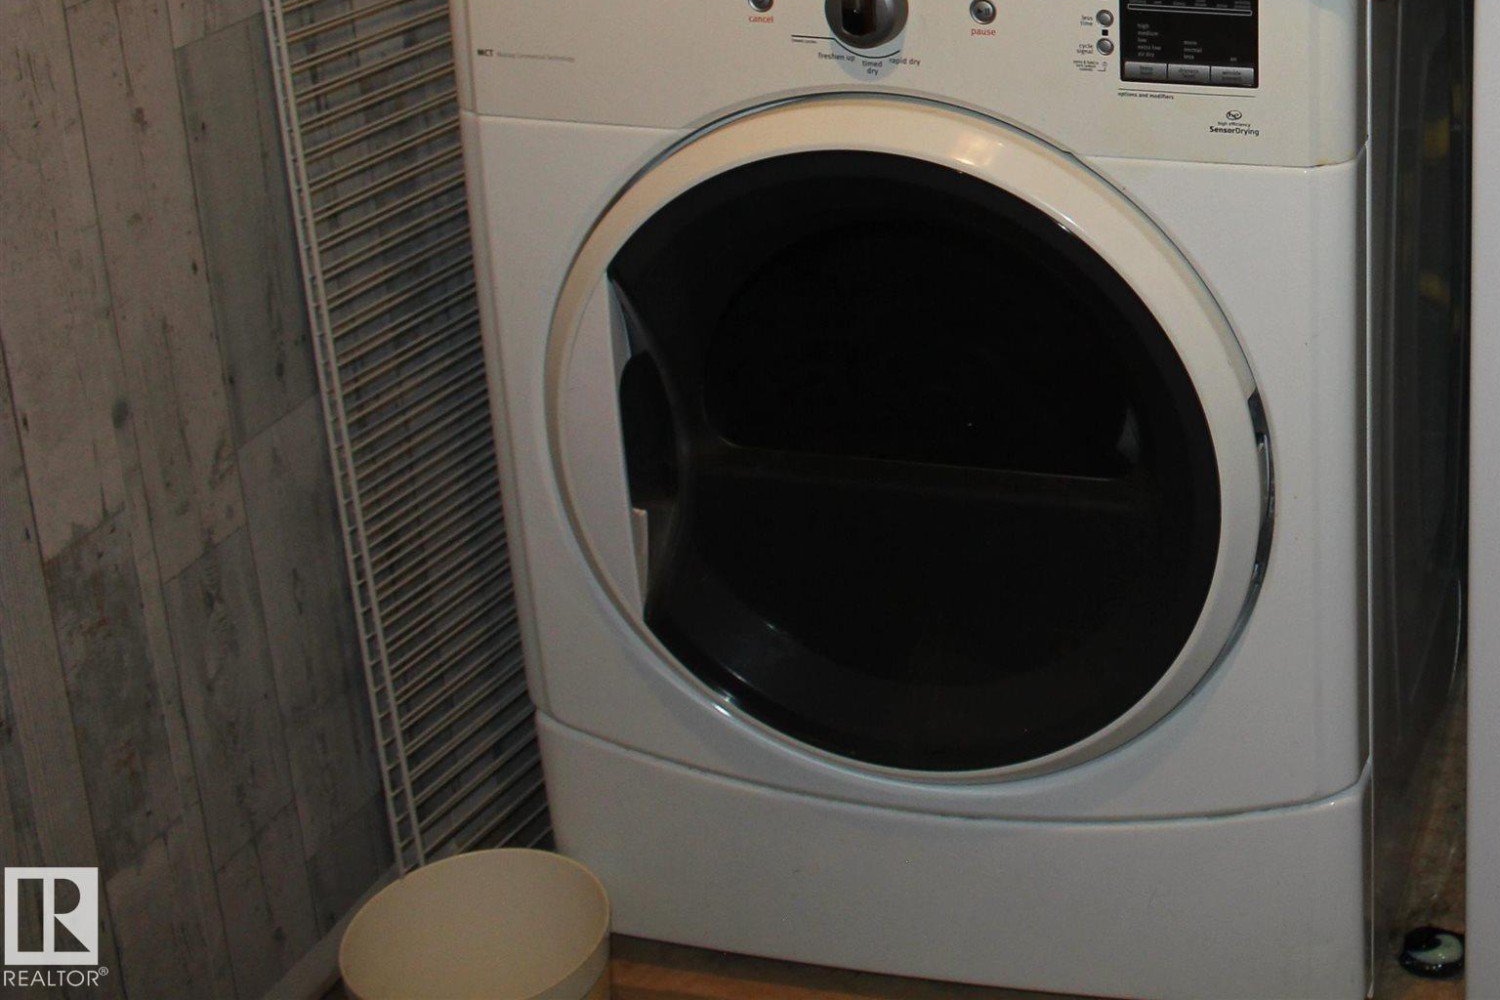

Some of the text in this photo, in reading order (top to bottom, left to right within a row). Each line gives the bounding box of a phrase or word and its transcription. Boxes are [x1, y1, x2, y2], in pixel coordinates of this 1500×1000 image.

[748, 15, 774, 23] cancel
[971, 27, 996, 36] pause
[1137, 23, 1150, 31] high
[889, 57, 921, 66] rapid dry
[867, 67, 879, 76] dry
[1117, 91, 1137, 99] options
[1209, 126, 1260, 137] SensorDrying
